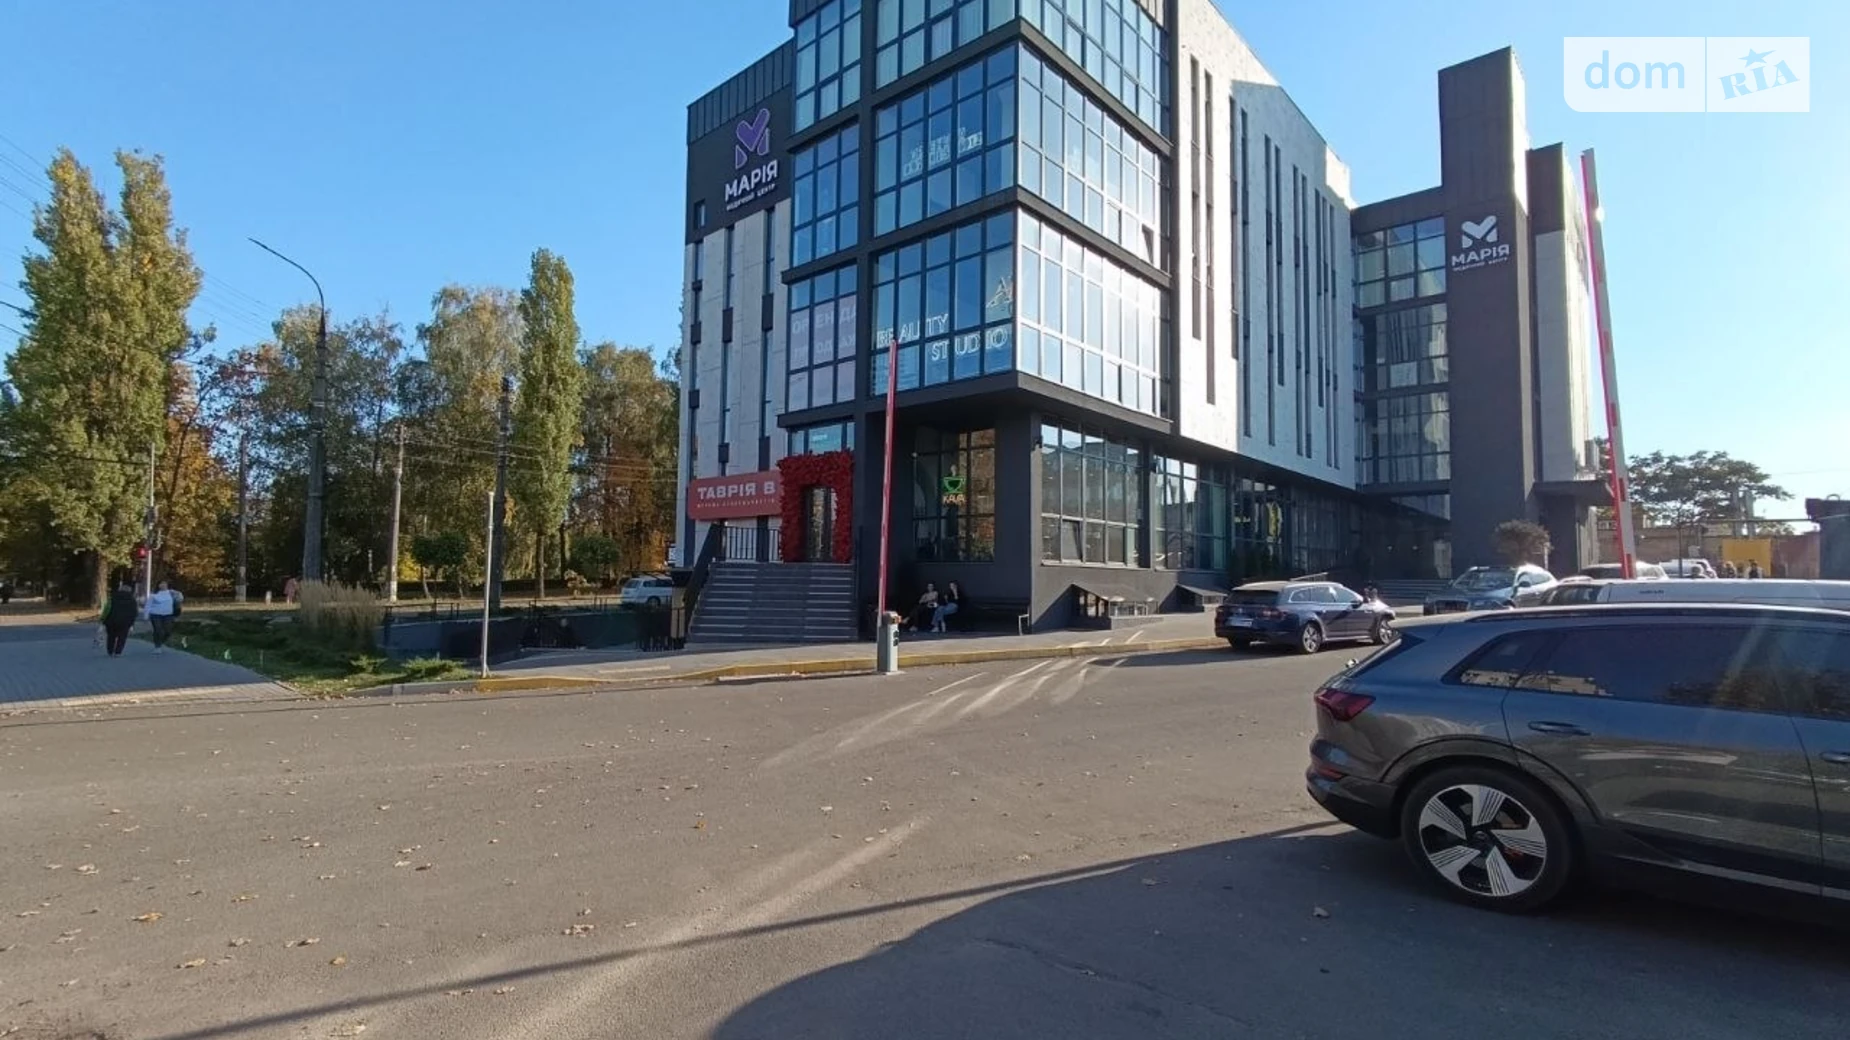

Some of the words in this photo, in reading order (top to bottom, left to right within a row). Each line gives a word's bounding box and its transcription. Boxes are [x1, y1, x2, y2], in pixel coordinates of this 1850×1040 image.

[725, 159, 778, 202] МАРІЯ
[1451, 244, 1510, 266] МАРІЯ
[931, 328, 1008, 361] STUDIO
[697, 482, 756, 500] ТАВРІЯ
